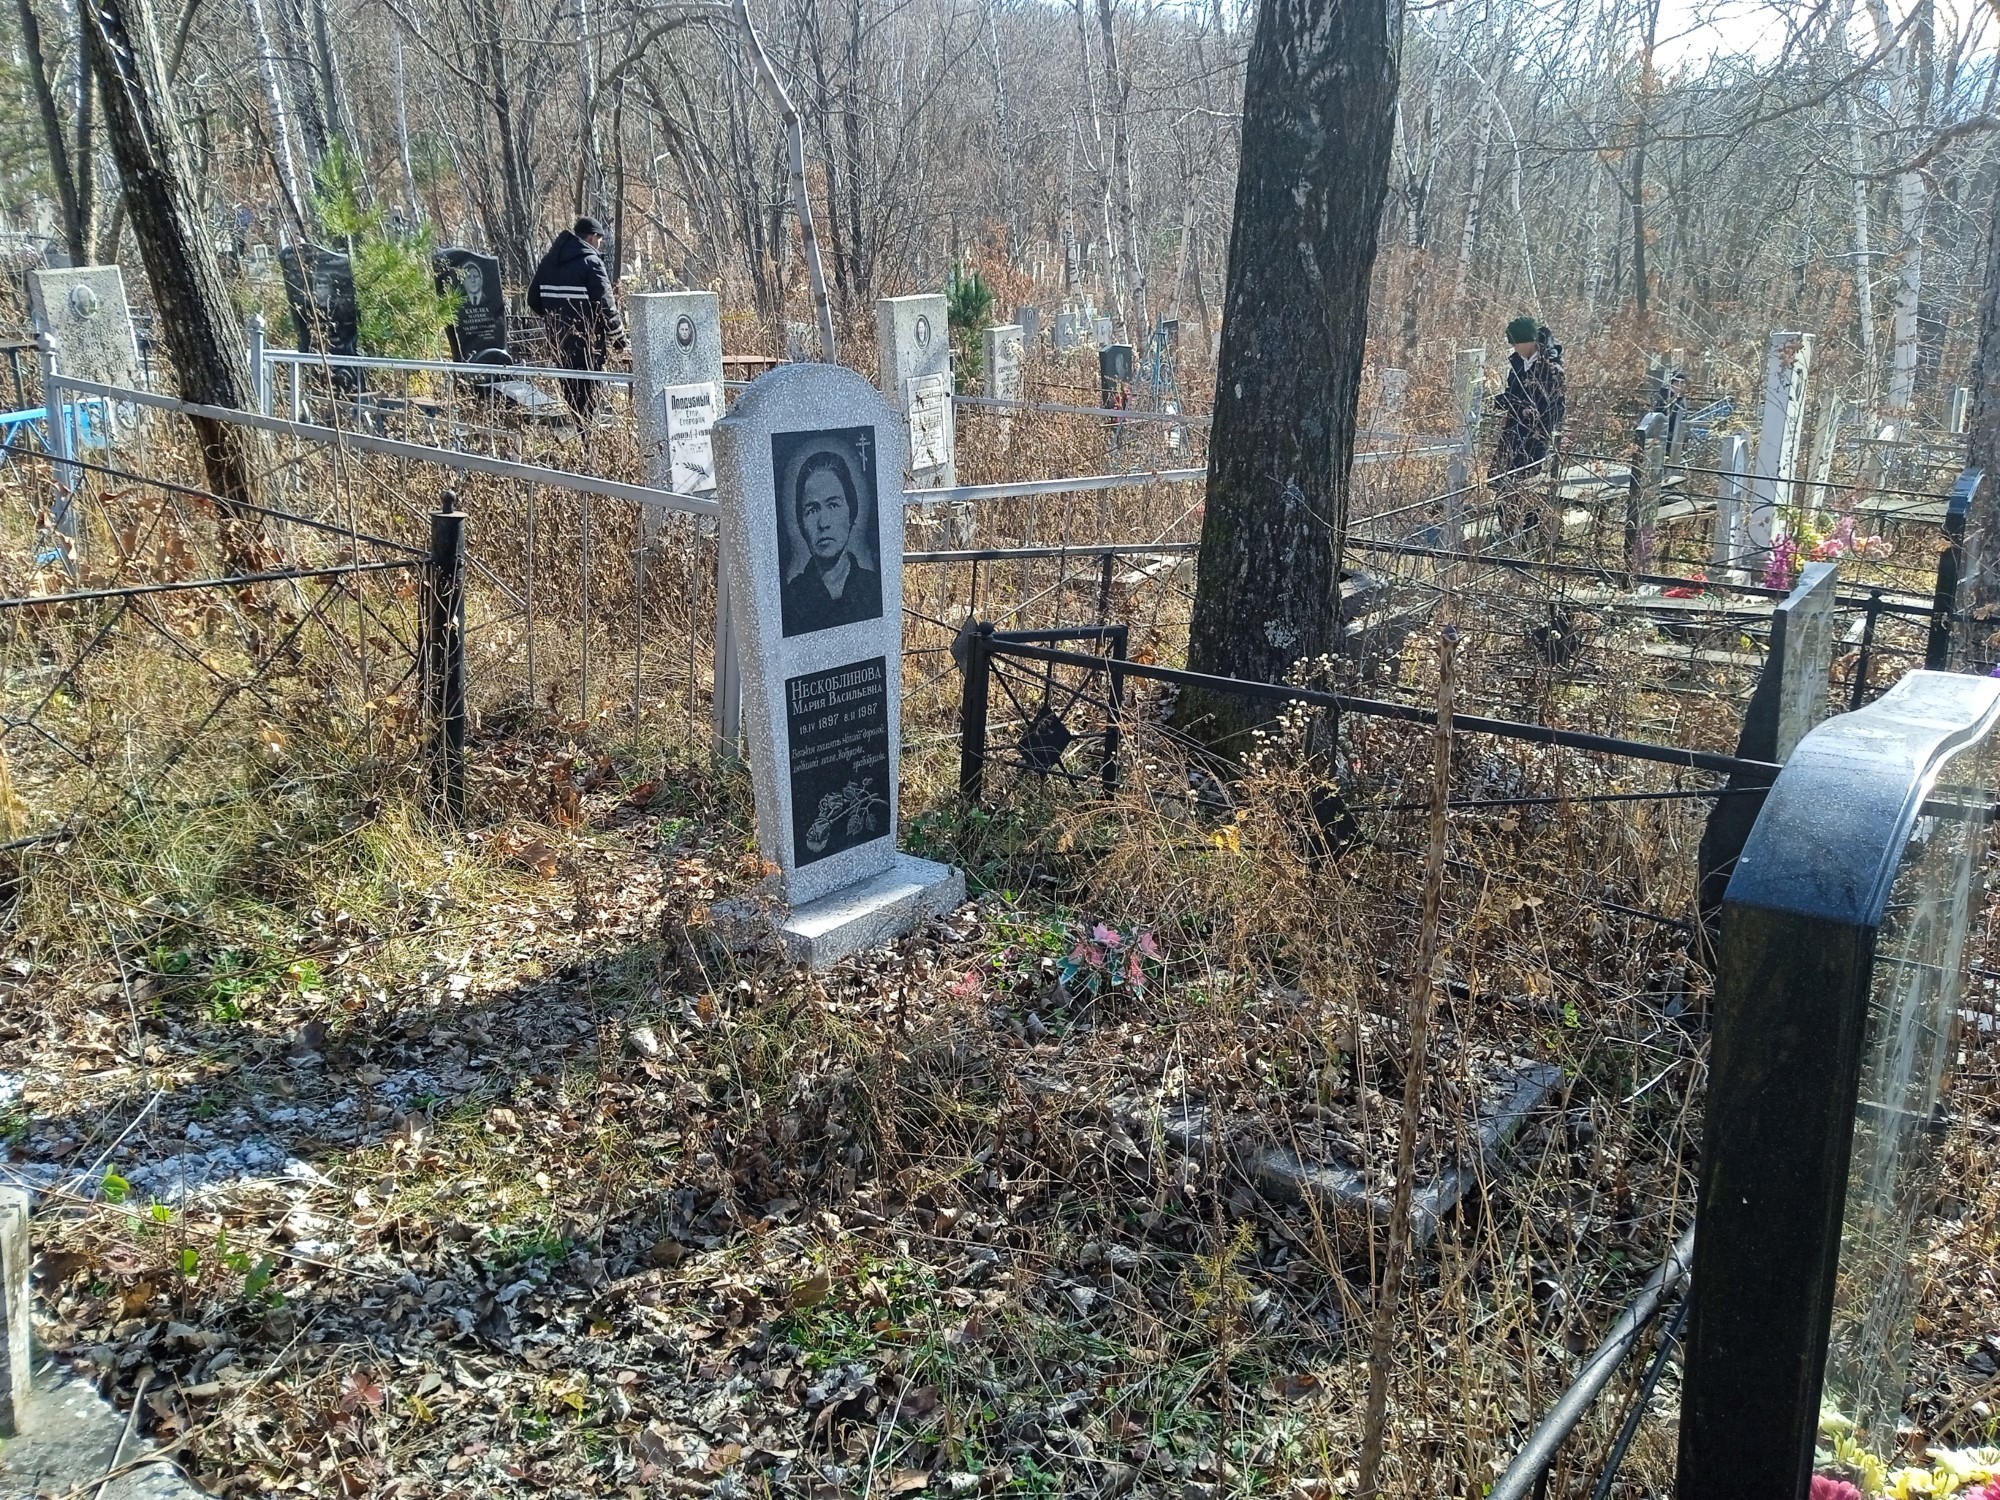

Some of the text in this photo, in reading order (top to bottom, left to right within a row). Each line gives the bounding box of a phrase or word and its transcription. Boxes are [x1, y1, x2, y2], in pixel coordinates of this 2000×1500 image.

[791, 666, 882, 701] НЕСКОБЛИНОВА
[792, 684, 882, 716] МАРИЯ ВАСИЛЬЕВНА
[818, 713, 839, 730] 1897
[858, 703, 878, 719] 1987
